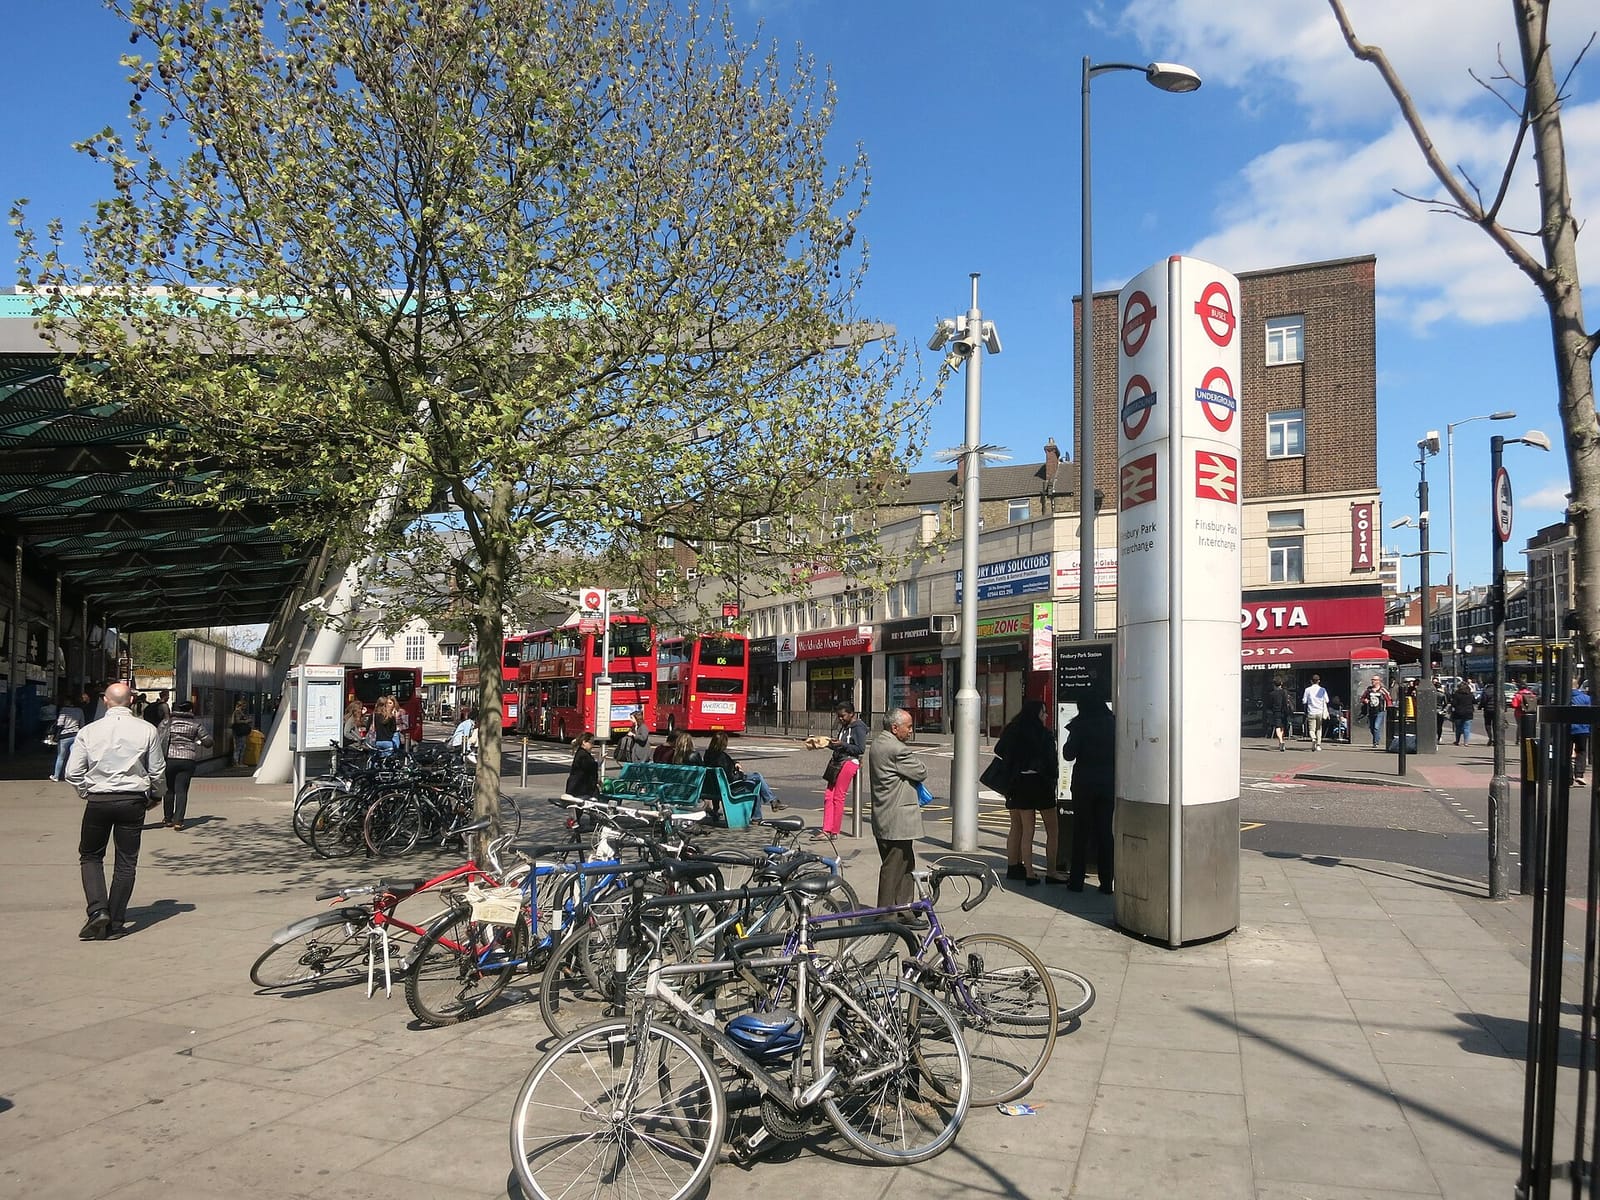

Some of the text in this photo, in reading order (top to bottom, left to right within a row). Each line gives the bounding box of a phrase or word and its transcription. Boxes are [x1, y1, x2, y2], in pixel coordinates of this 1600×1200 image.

[1211, 308, 1227, 321] BUSES
[1123, 395, 1155, 416] RGROUND
[1196, 390, 1235, 408] UNDERGROUND
[1141, 522, 1157, 535] Park
[1195, 519, 1226, 534] Finsbury
[1358, 508, 1368, 562] COSTA
[1122, 540, 1154, 556] terchange
[1198, 536, 1236, 552] Interchange
[991, 563, 1005, 575] LAW
[1008, 555, 1049, 573] SOLICITORS
[1241, 606, 1309, 631] OSTA
[904, 629, 928, 638] PROPERTY
[994, 619, 1019, 634] ZONE
[618, 646, 627, 656] 19
[798, 639, 823, 651] Worldwide
[823, 637, 841, 649] Money
[1241, 647, 1294, 656] OSTA
[716, 657, 727, 665] 106
[1243, 662, 1291, 671] COFFEE LOVERS
